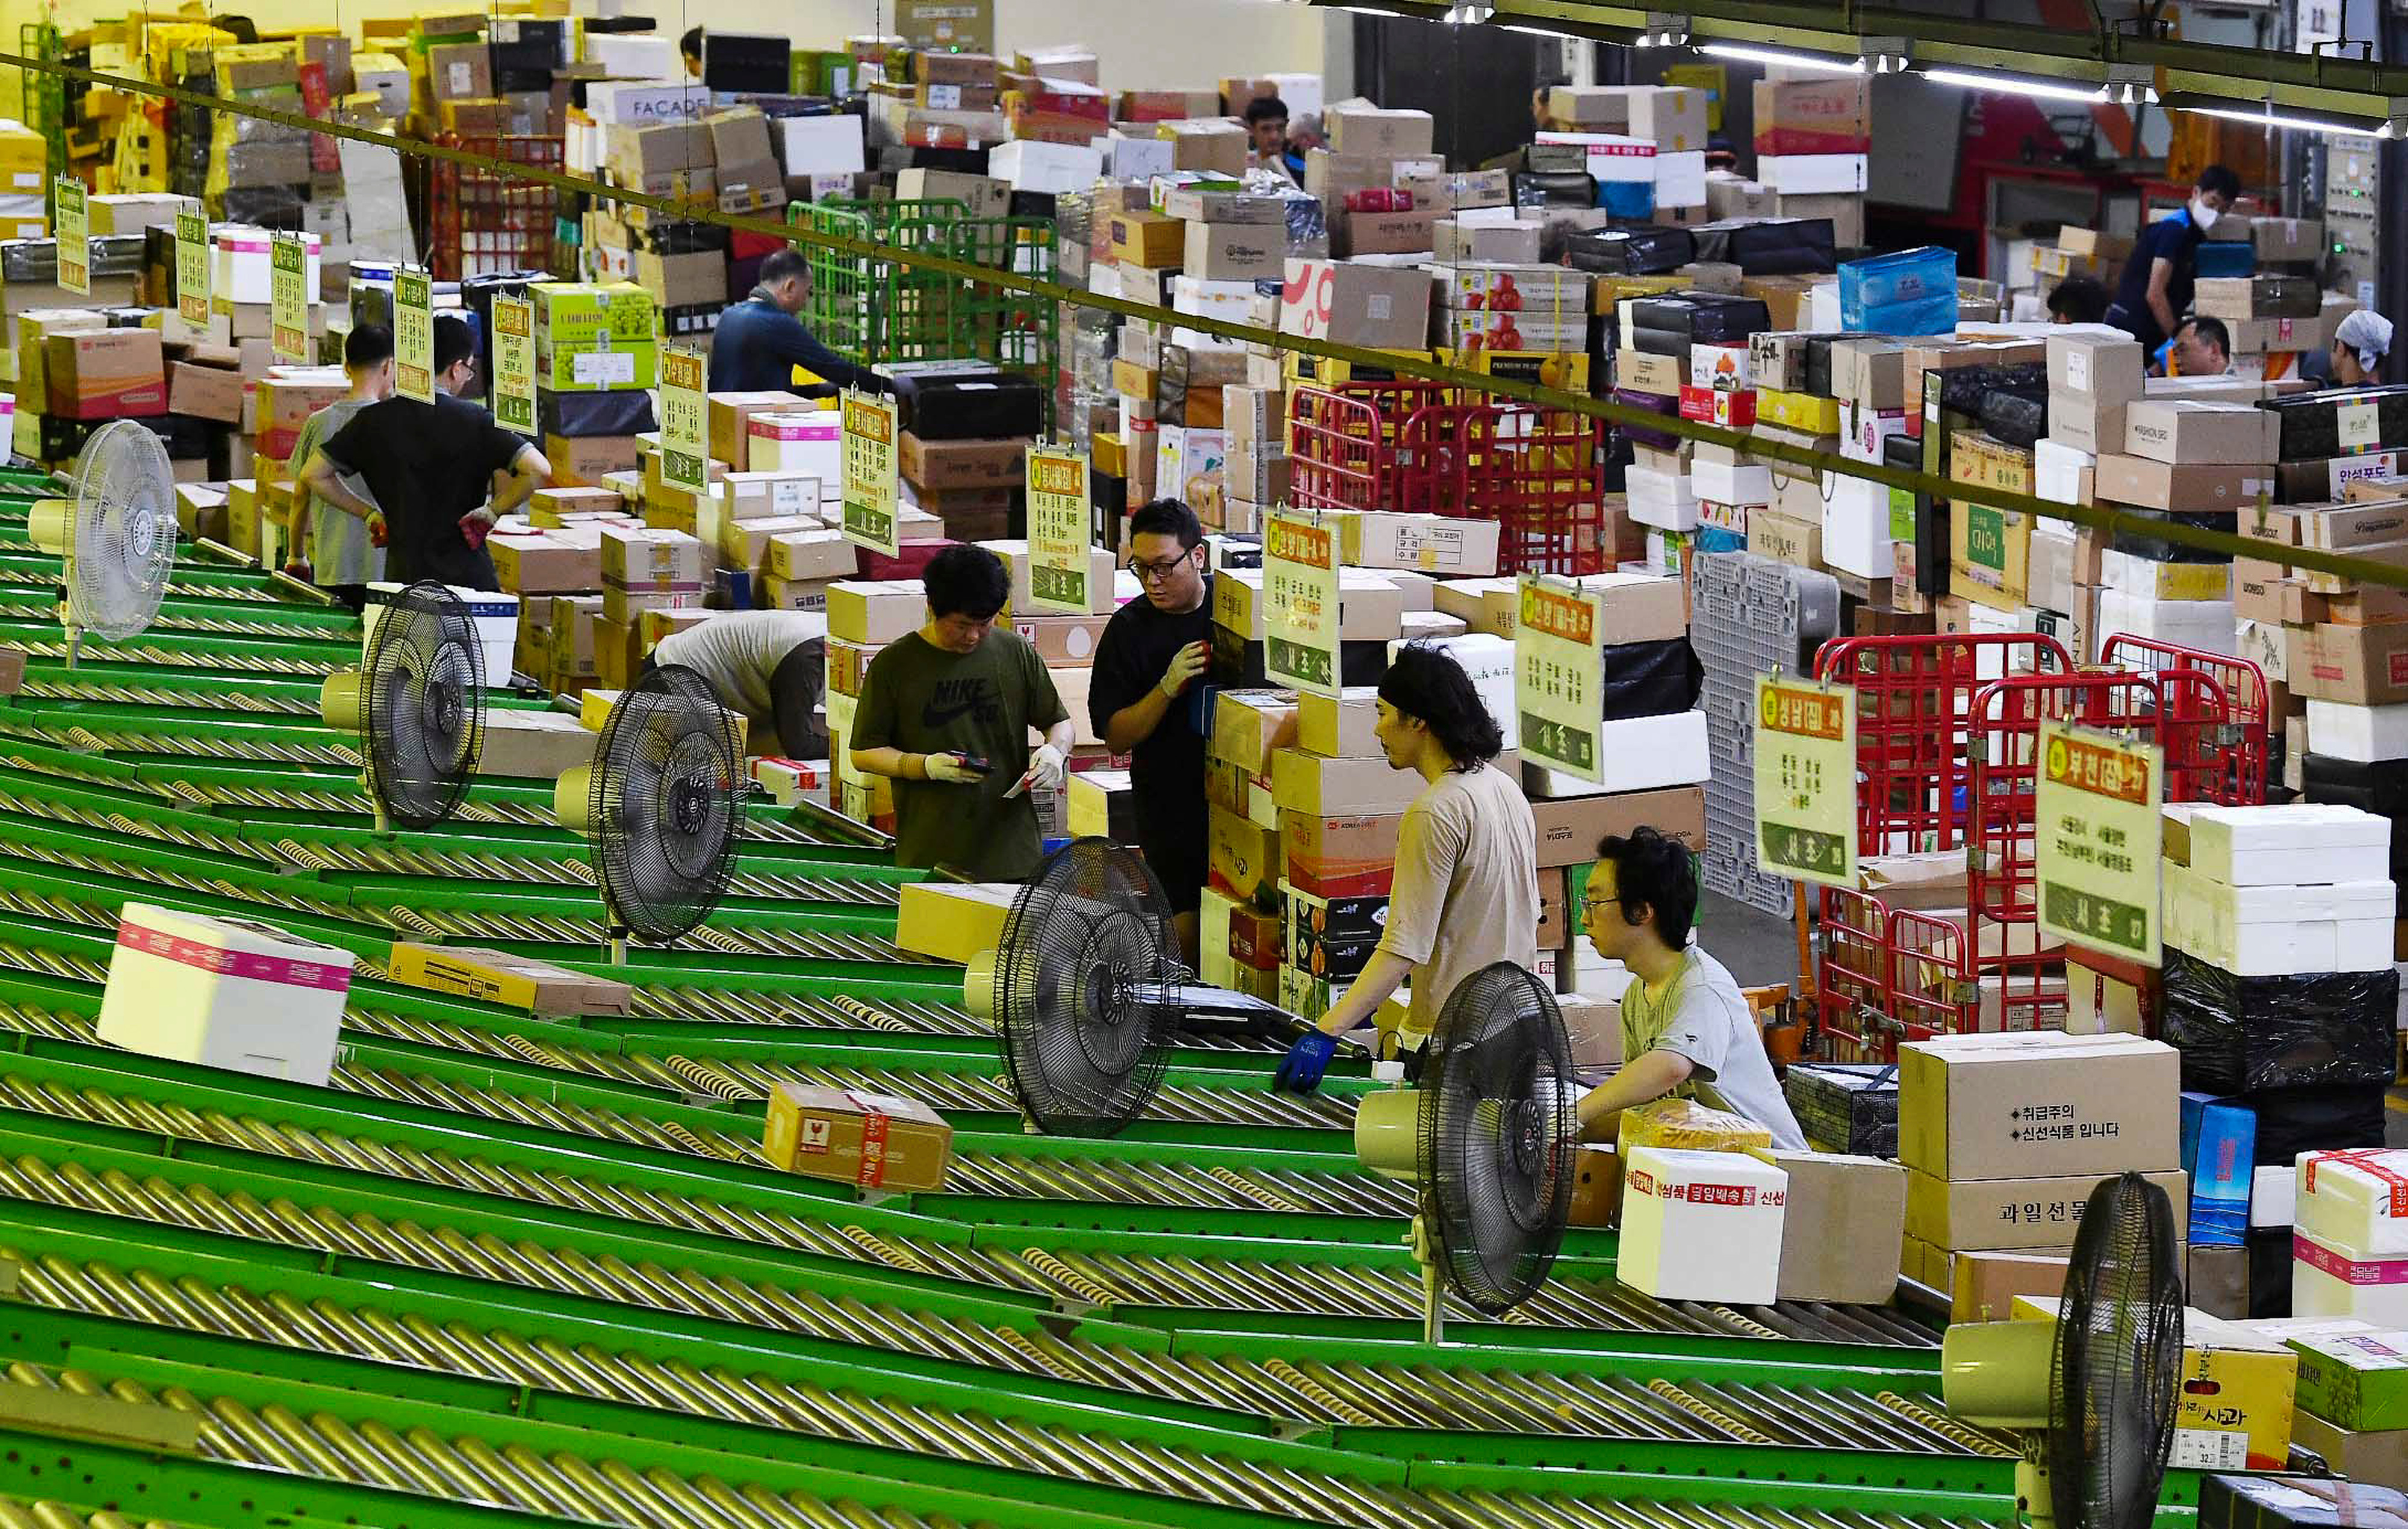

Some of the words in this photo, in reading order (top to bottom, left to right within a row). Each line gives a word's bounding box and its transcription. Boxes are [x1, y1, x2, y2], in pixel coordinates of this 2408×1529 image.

[936, 678, 988, 703] NIKE
[2023, 1105, 2074, 1120] 취급주의
[2023, 1124, 2074, 1141] 신선식품
[2080, 1122, 2120, 1138] 입니다
[2202, 1409, 2247, 1426] 사과
